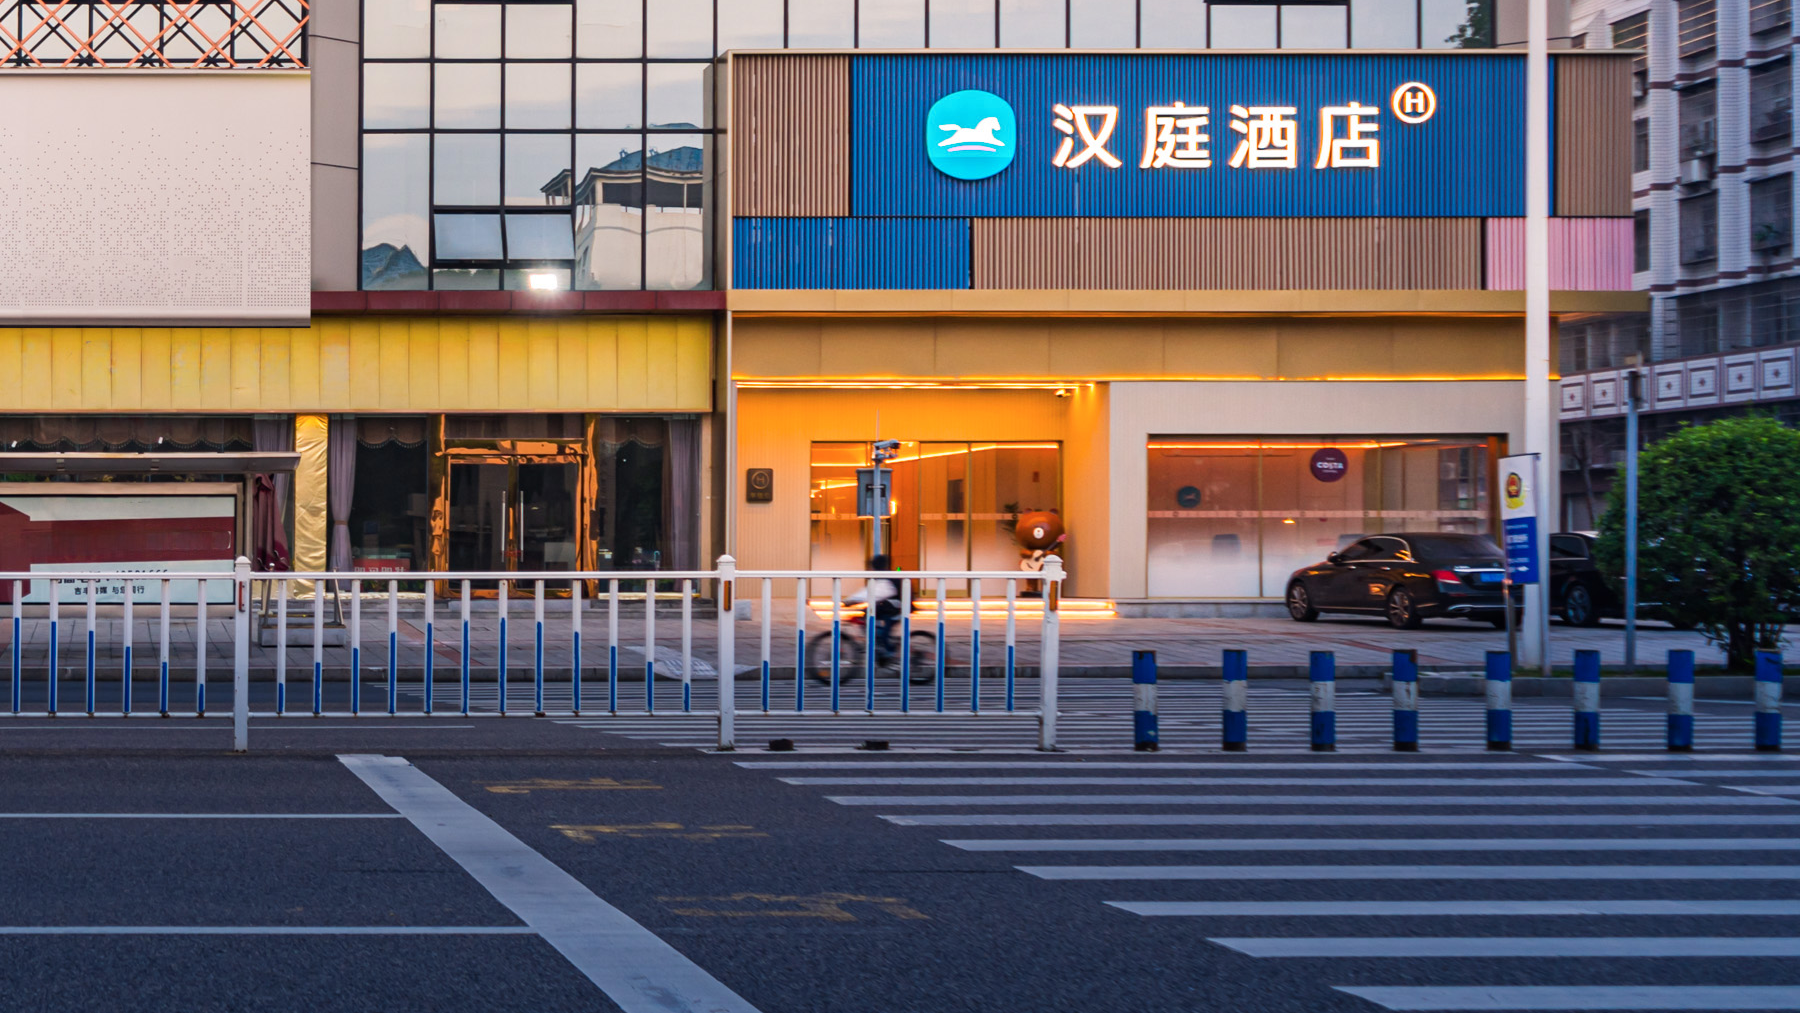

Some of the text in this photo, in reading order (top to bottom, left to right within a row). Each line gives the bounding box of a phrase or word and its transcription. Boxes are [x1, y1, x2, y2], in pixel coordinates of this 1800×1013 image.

[1050, 101, 1382, 170] 汉庭酒店
[1316, 461, 1344, 469] COSTA
